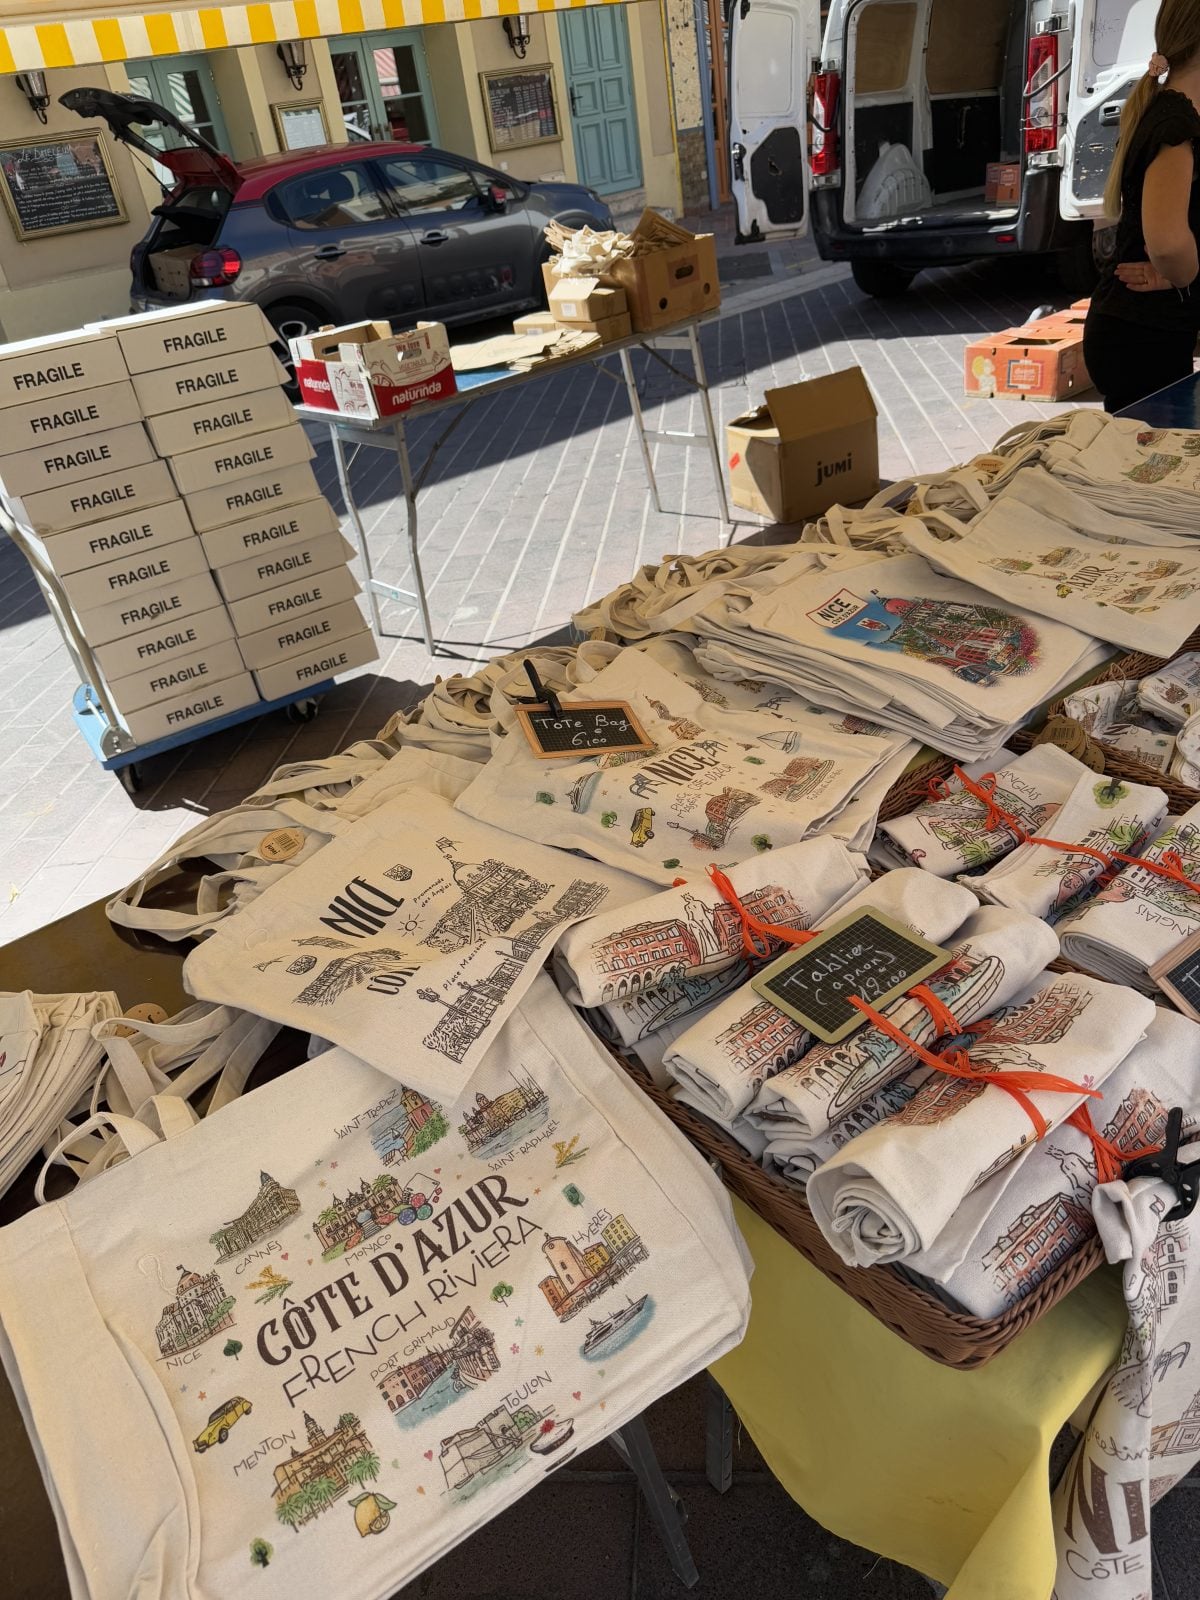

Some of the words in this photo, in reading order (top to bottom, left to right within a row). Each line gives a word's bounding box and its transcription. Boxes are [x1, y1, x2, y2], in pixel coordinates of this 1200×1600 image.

[163, 327, 227, 353] FRAGILE
[13, 363, 84, 390] FRAGILE
[176, 369, 239, 395] FRAGILE
[392, 381, 442, 406] naturinda
[30, 405, 99, 433] FRAGILE
[193, 409, 253, 435] FRAGILE
[44, 445, 111, 473] FRAGILE
[214, 447, 274, 473] FRAGILE
[70, 484, 136, 512] FRAGILE
[226, 483, 283, 510] FRAGILE
[89, 525, 153, 553] FRAGILE
[243, 520, 299, 548] FRAGILE
[108, 560, 170, 589] FRAGILE
[257, 552, 312, 579] FRAGILE
[120, 596, 182, 625] FRAGILE
[268, 588, 322, 615] FRAGILE
[817, 598, 851, 621] NICE
[137, 629, 197, 658] FRAGILE
[277, 621, 331, 648] FRAGILE
[150, 663, 208, 692] FRAGILE
[296, 653, 348, 680] FRAGILE
[166, 696, 224, 725] FRAGILE
[596, 715, 632, 731] Bag
[642, 746, 720, 786] NICE
[413, 877, 445, 903] Promenade
[421, 895, 431, 908] des
[431, 883, 452, 898] Anglais
[320, 875, 405, 938] NICE
[442, 970, 462, 991] Place
[783, 944, 874, 989] Tablier
[572, 1208, 613, 1245] HYÈRES
[234, 1240, 283, 1276] CANNES
[256, 1271, 374, 1366] CÔTE
[369, 1174, 529, 1298] D'AZUR
[282, 1300, 428, 1408] FRENCH
[370, 1354, 399, 1382] PORT
[233, 1430, 297, 1477] MENTON
